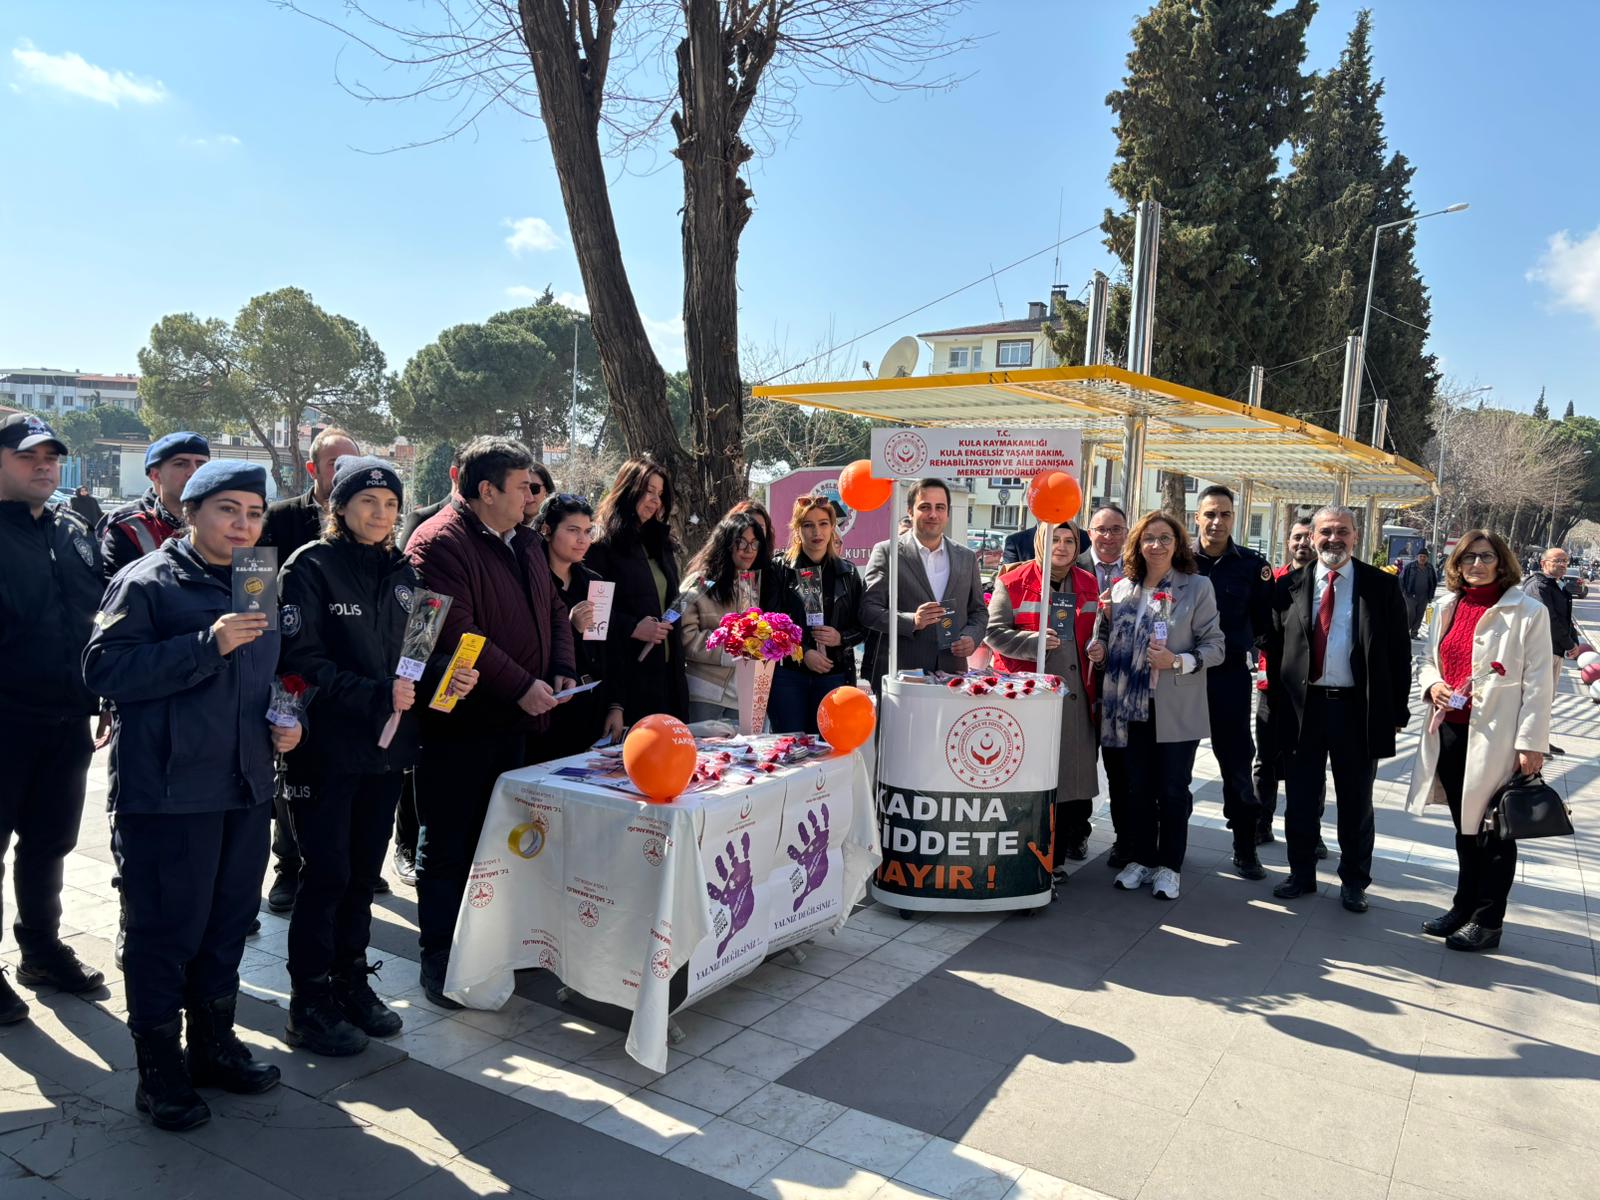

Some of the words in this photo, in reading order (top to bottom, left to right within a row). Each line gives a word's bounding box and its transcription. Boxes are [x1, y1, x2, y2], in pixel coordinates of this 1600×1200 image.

[996, 429, 1011, 437] T.C.
[983, 438, 1048, 447] KAYMAKAMLIĞI
[940, 449, 963, 457] KULA
[964, 448, 1005, 457] ENGELSİZ
[1005, 449, 1034, 459] YAŞAM
[1035, 449, 1065, 458] BAKIM,
[929, 458, 1001, 467] REHABİLİTASYON
[1002, 459, 1014, 467] VE
[1015, 458, 1034, 467] AİLE
[1035, 459, 1074, 468] DANIŞMA
[956, 467, 994, 476] MERKEZİ
[329, 603, 363, 616] POLİS
[282, 784, 311, 798] OLİS
[881, 818, 1019, 856] İDDETE
[985, 865, 997, 889] !
[774, 913, 797, 930] YALNIZ
[798, 897, 831, 920] DEĞİLSİNİZ
[696, 960, 721, 981] YALNIZ
[721, 939, 757, 966] DEĞİLSİNİZ
